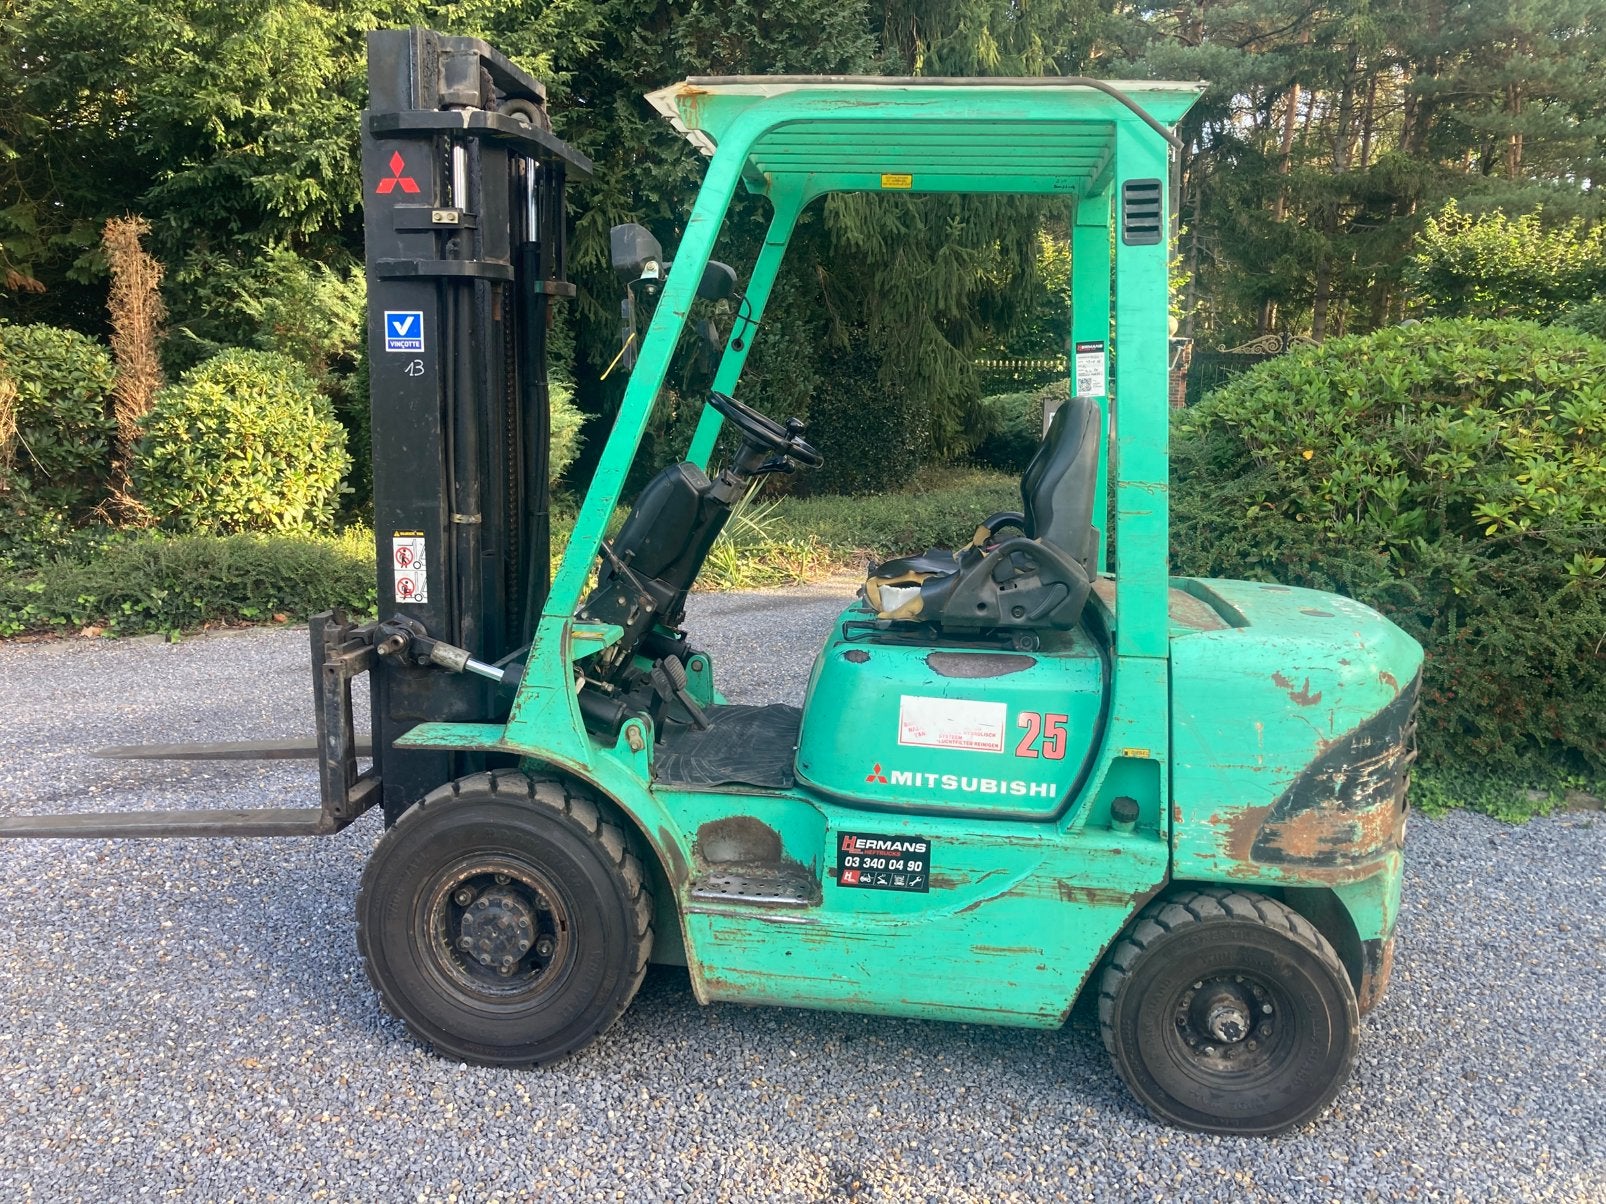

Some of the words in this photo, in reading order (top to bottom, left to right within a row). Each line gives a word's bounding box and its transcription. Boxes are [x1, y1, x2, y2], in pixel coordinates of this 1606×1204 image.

[404, 359, 425, 377] 13
[1015, 711, 1069, 761] 25
[890, 770, 1057, 798] MITSUBISHI
[841, 835, 927, 854] HERMANS
[844, 856, 860, 867] 03
[863, 857, 886, 869] 340
[888, 859, 904, 871] 04
[906, 860, 923, 872] 90
